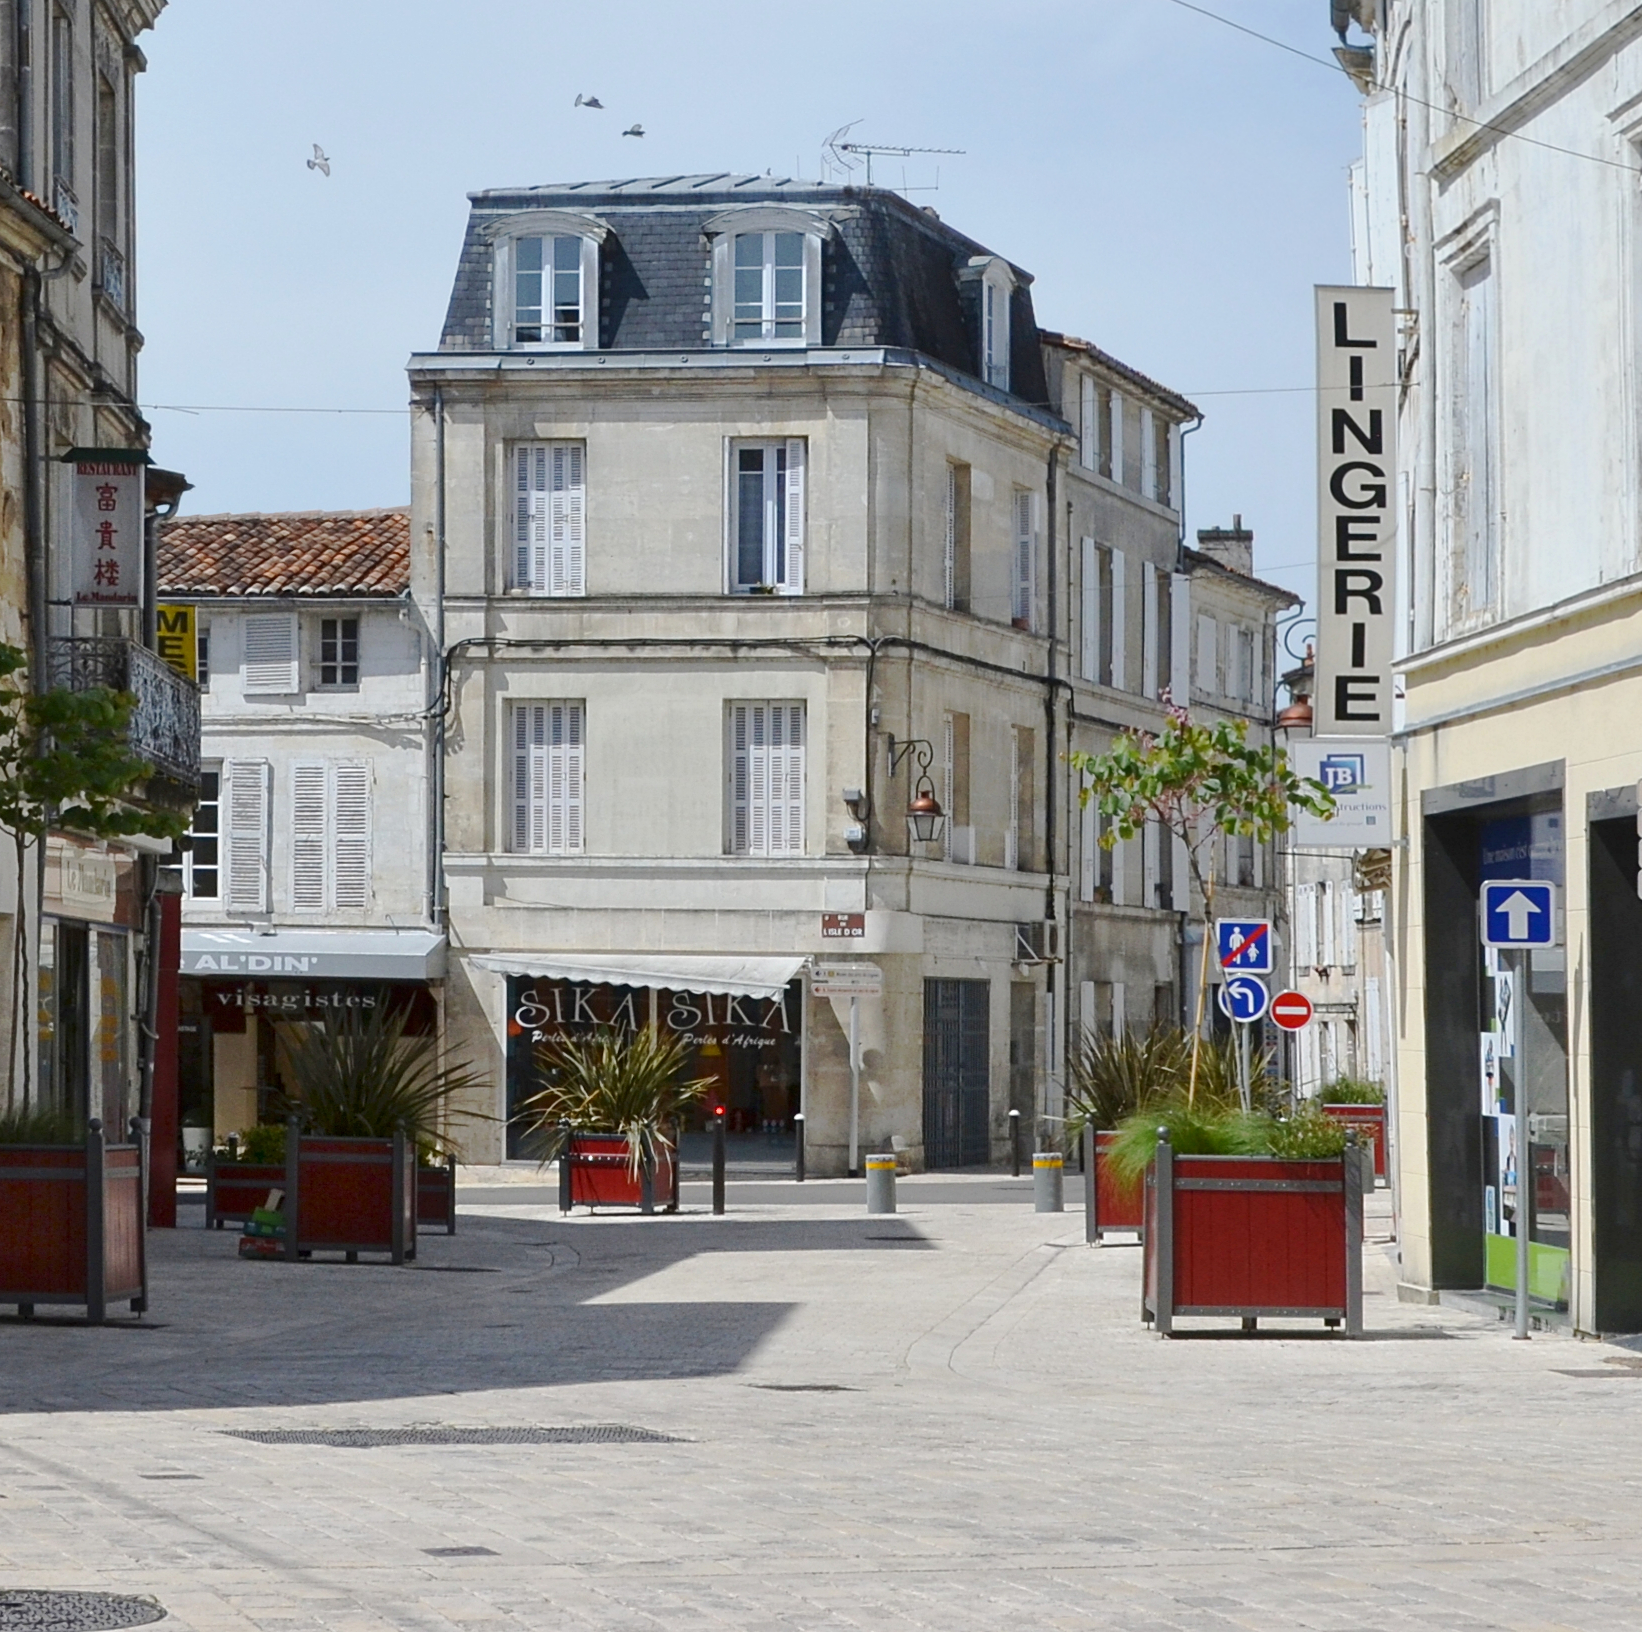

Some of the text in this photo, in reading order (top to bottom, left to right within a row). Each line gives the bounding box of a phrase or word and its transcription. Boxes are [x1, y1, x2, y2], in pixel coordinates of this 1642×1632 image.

[76, 462, 137, 477] RESTAURANT
[1329, 301, 1387, 722] LINGERIE
[90, 591, 138, 603] Mandarin
[1325, 767, 1353, 789] JB
[194, 954, 318, 972] AL'DIN'
[218, 989, 376, 1011] visagistes
[515, 986, 792, 1035] SIKA SIKA
[682, 1033, 777, 1049] Perles d'Afrique
